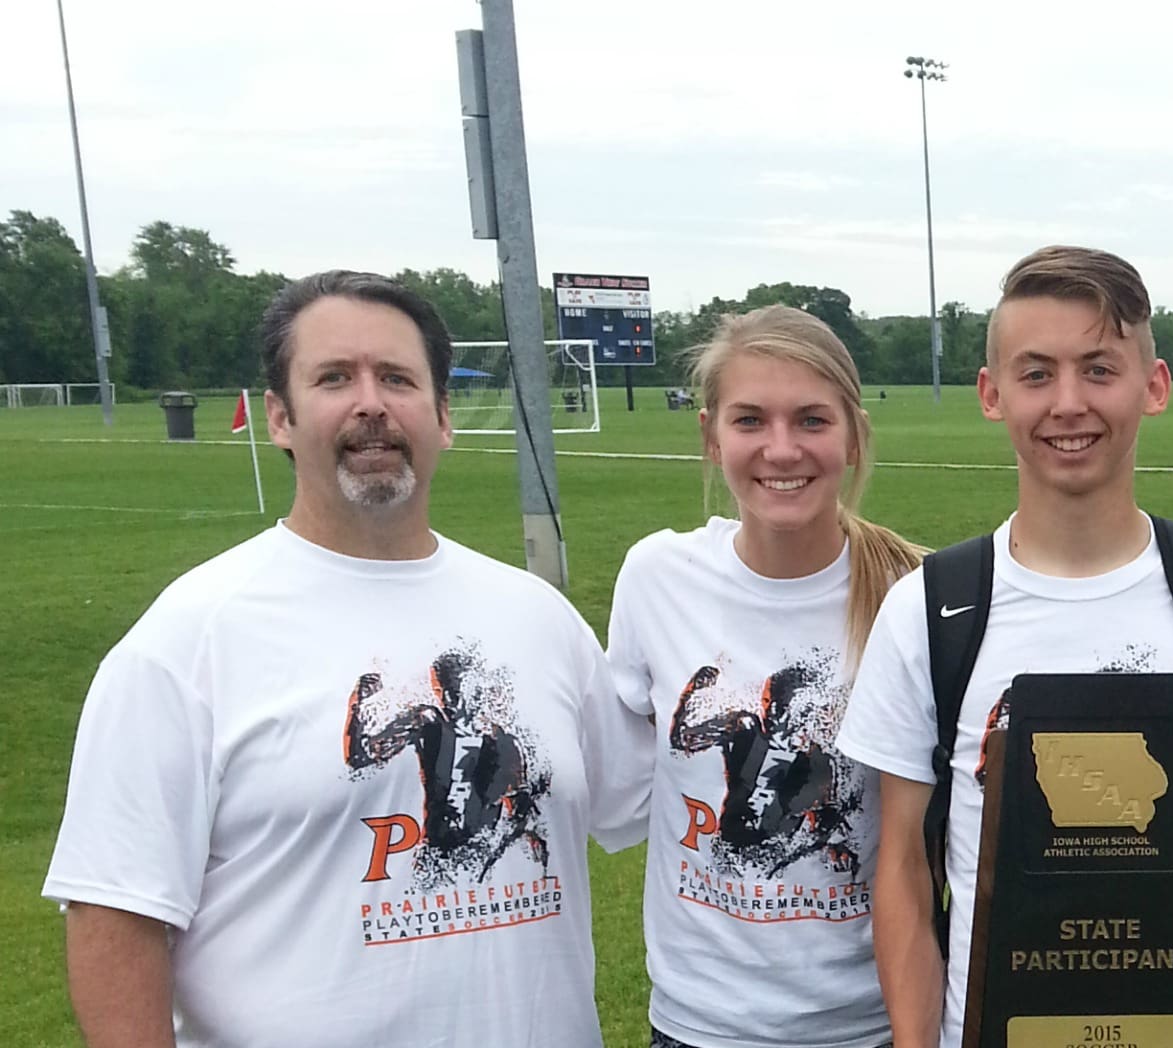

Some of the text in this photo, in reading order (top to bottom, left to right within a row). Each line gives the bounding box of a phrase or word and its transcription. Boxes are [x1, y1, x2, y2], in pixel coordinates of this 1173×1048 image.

[680, 792, 717, 852] P
[360, 813, 421, 882] P
[1053, 836, 1150, 846] IOWA HIGH SCHOOL
[1043, 847, 1159, 857] ATHLETIC ASSOCIATION
[361, 890, 477, 918] PRAIRIE
[364, 925, 440, 941] STATE
[1059, 919, 1141, 940] STATE
[1083, 1025, 1121, 1042] 2015
